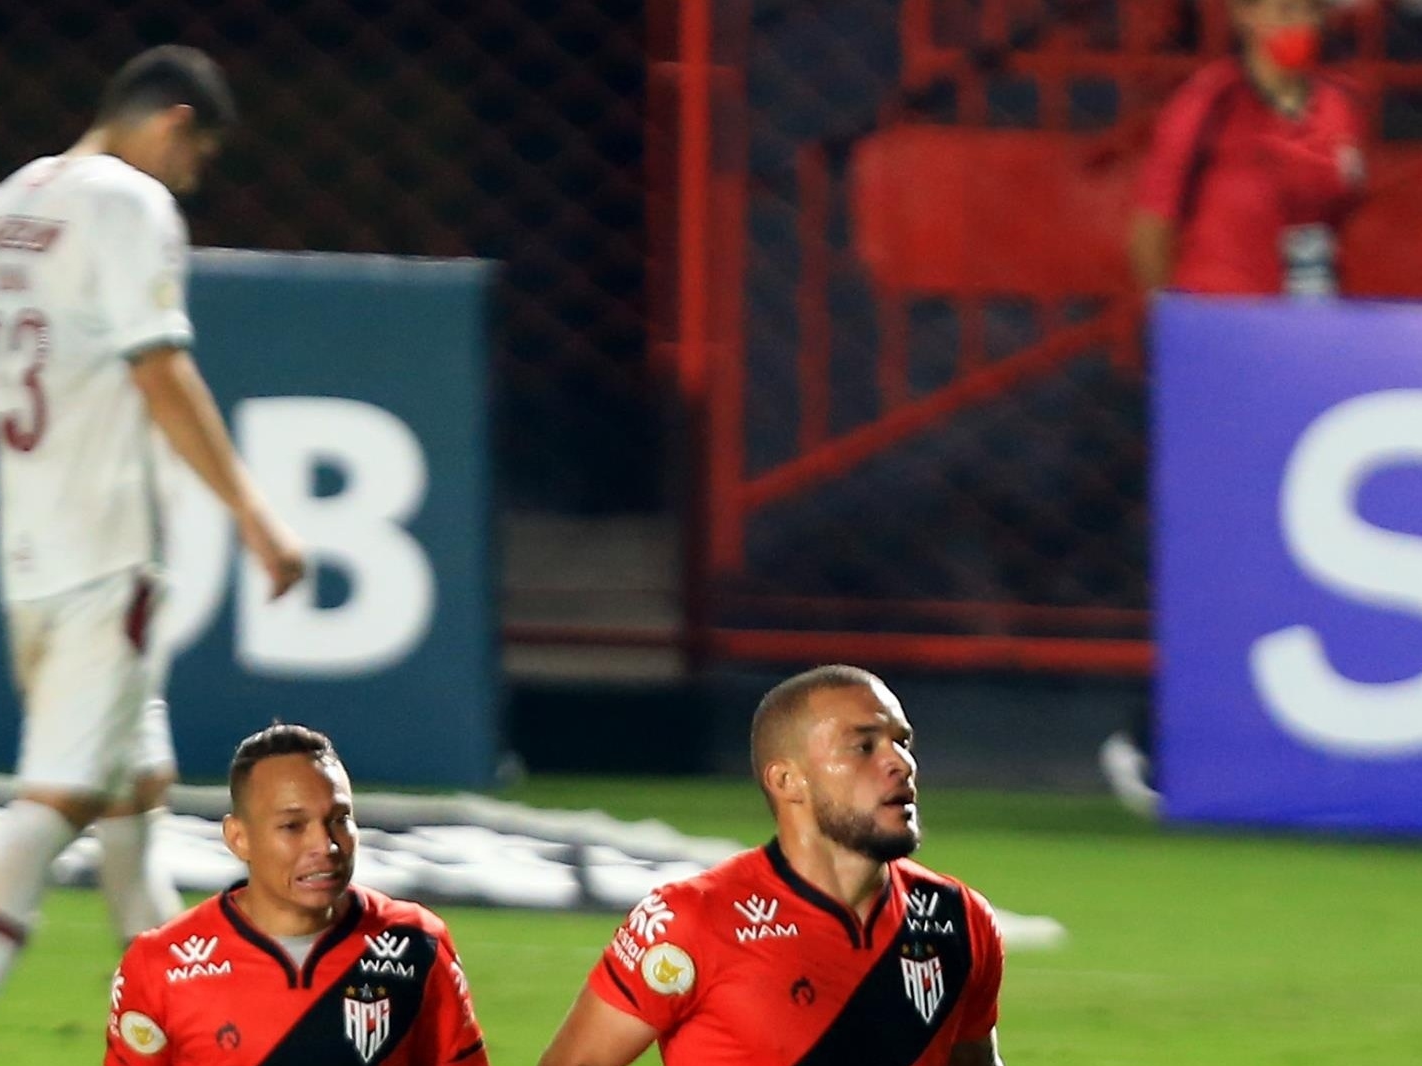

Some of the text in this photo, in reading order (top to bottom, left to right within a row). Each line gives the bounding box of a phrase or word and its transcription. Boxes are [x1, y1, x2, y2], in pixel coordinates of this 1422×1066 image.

[735, 922, 800, 943] WAM
[166, 959, 232, 983] WAM
[359, 957, 416, 979] WAM
